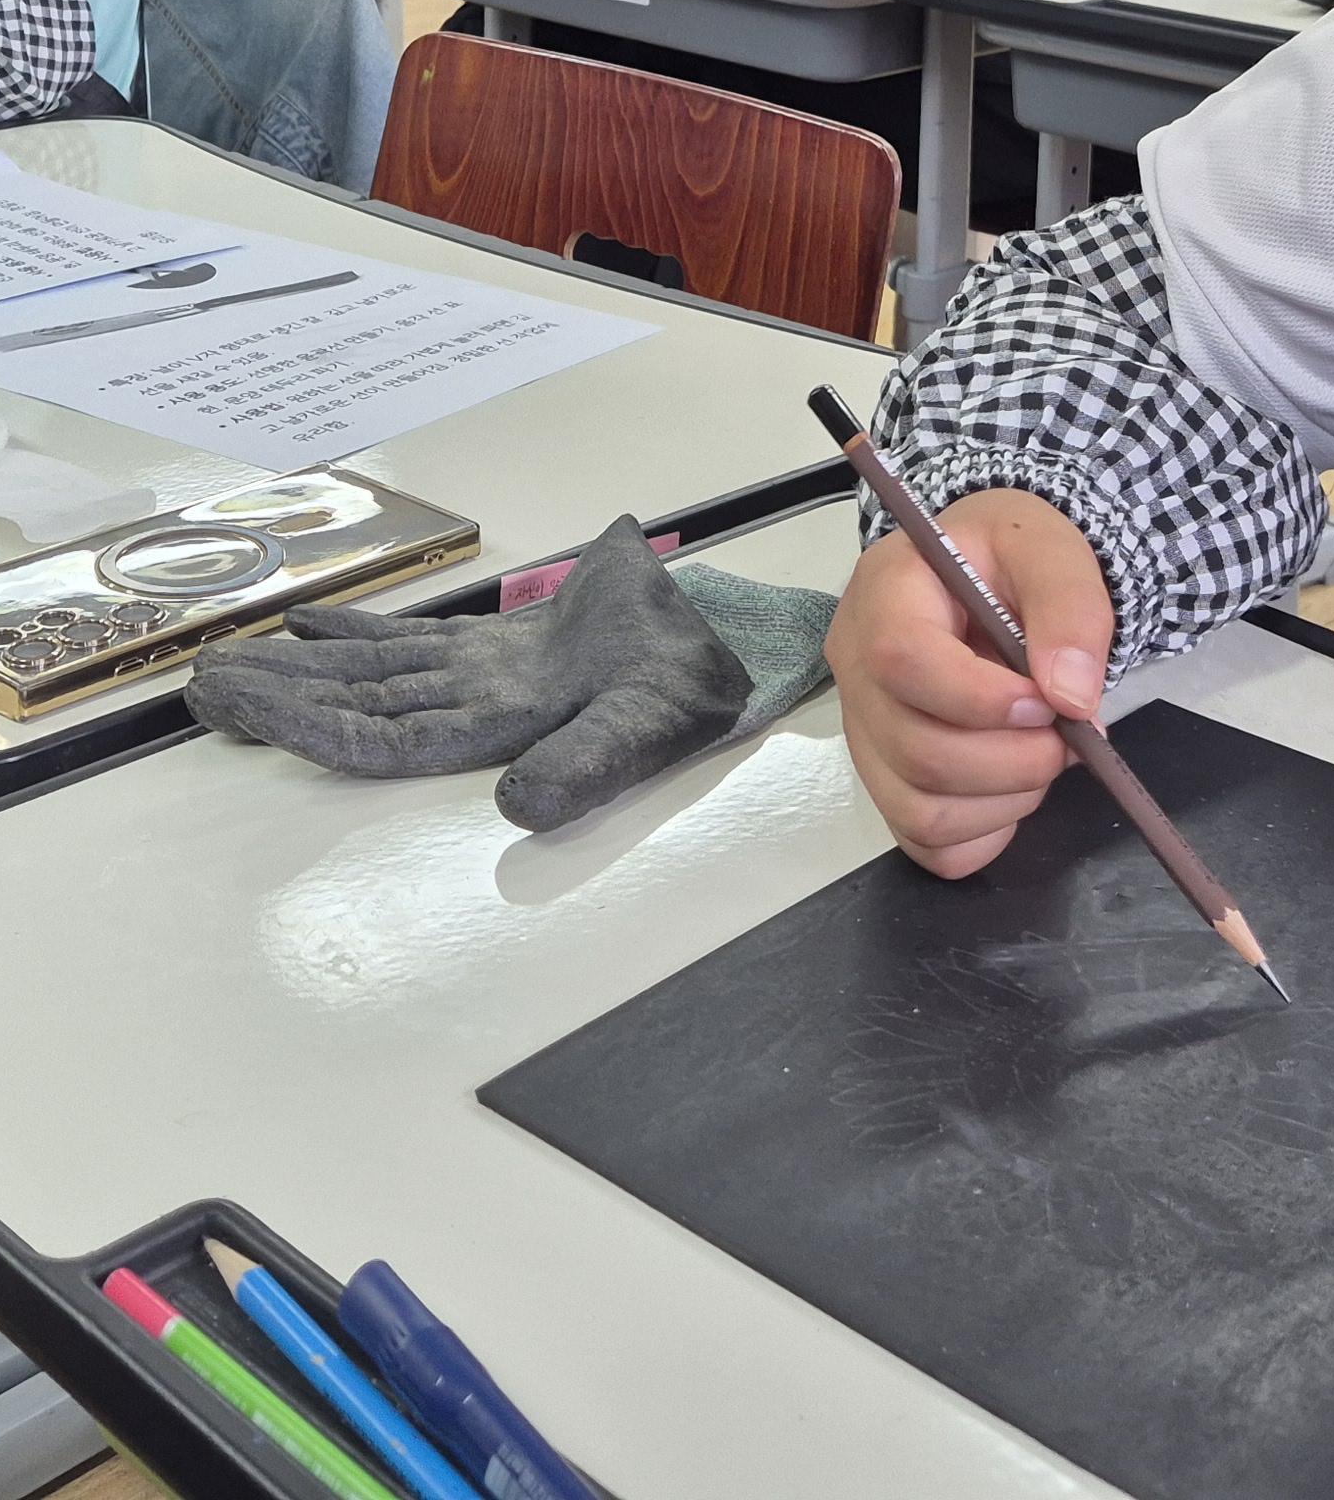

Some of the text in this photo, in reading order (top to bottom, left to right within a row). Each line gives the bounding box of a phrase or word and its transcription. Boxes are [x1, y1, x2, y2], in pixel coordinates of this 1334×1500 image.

[150, 359, 191, 374] 날이
[185, 348, 221, 362] V자
[218, 332, 270, 351] 형태로
[269, 321, 305, 335] 생긴
[323, 303, 358, 316] 깊고
[354, 282, 416, 306] 날카로운
[168, 390, 206, 406] 사용
[247, 358, 299, 379] 선명한
[296, 341, 348, 362] 윤곽선
[395, 313, 429, 327] 음각
[427, 306, 447, 316] 선
[442, 300, 463, 309] 표
[286, 383, 341, 403] 원하는
[338, 370, 375, 385] 선을
[370, 357, 408, 372] 따라
[403, 341, 455, 361] 가볍게
[448, 329, 485, 344] 눌러
[479, 318, 515, 333] 파면
[509, 312, 532, 321] 깊
[139, 381, 177, 396] 선을
[176, 369, 214, 384] 새길
[214, 363, 231, 372] 수
[223, 389, 262, 405] 문양
[259, 372, 315, 393] 테두리
[259, 423, 284, 434] 고
[279, 398, 352, 425] 날카로운
[349, 384, 387, 400] 선이
[447, 344, 499, 363] 정밀한
[495, 337, 516, 346] 선
[510, 321, 559, 339] 작업에
